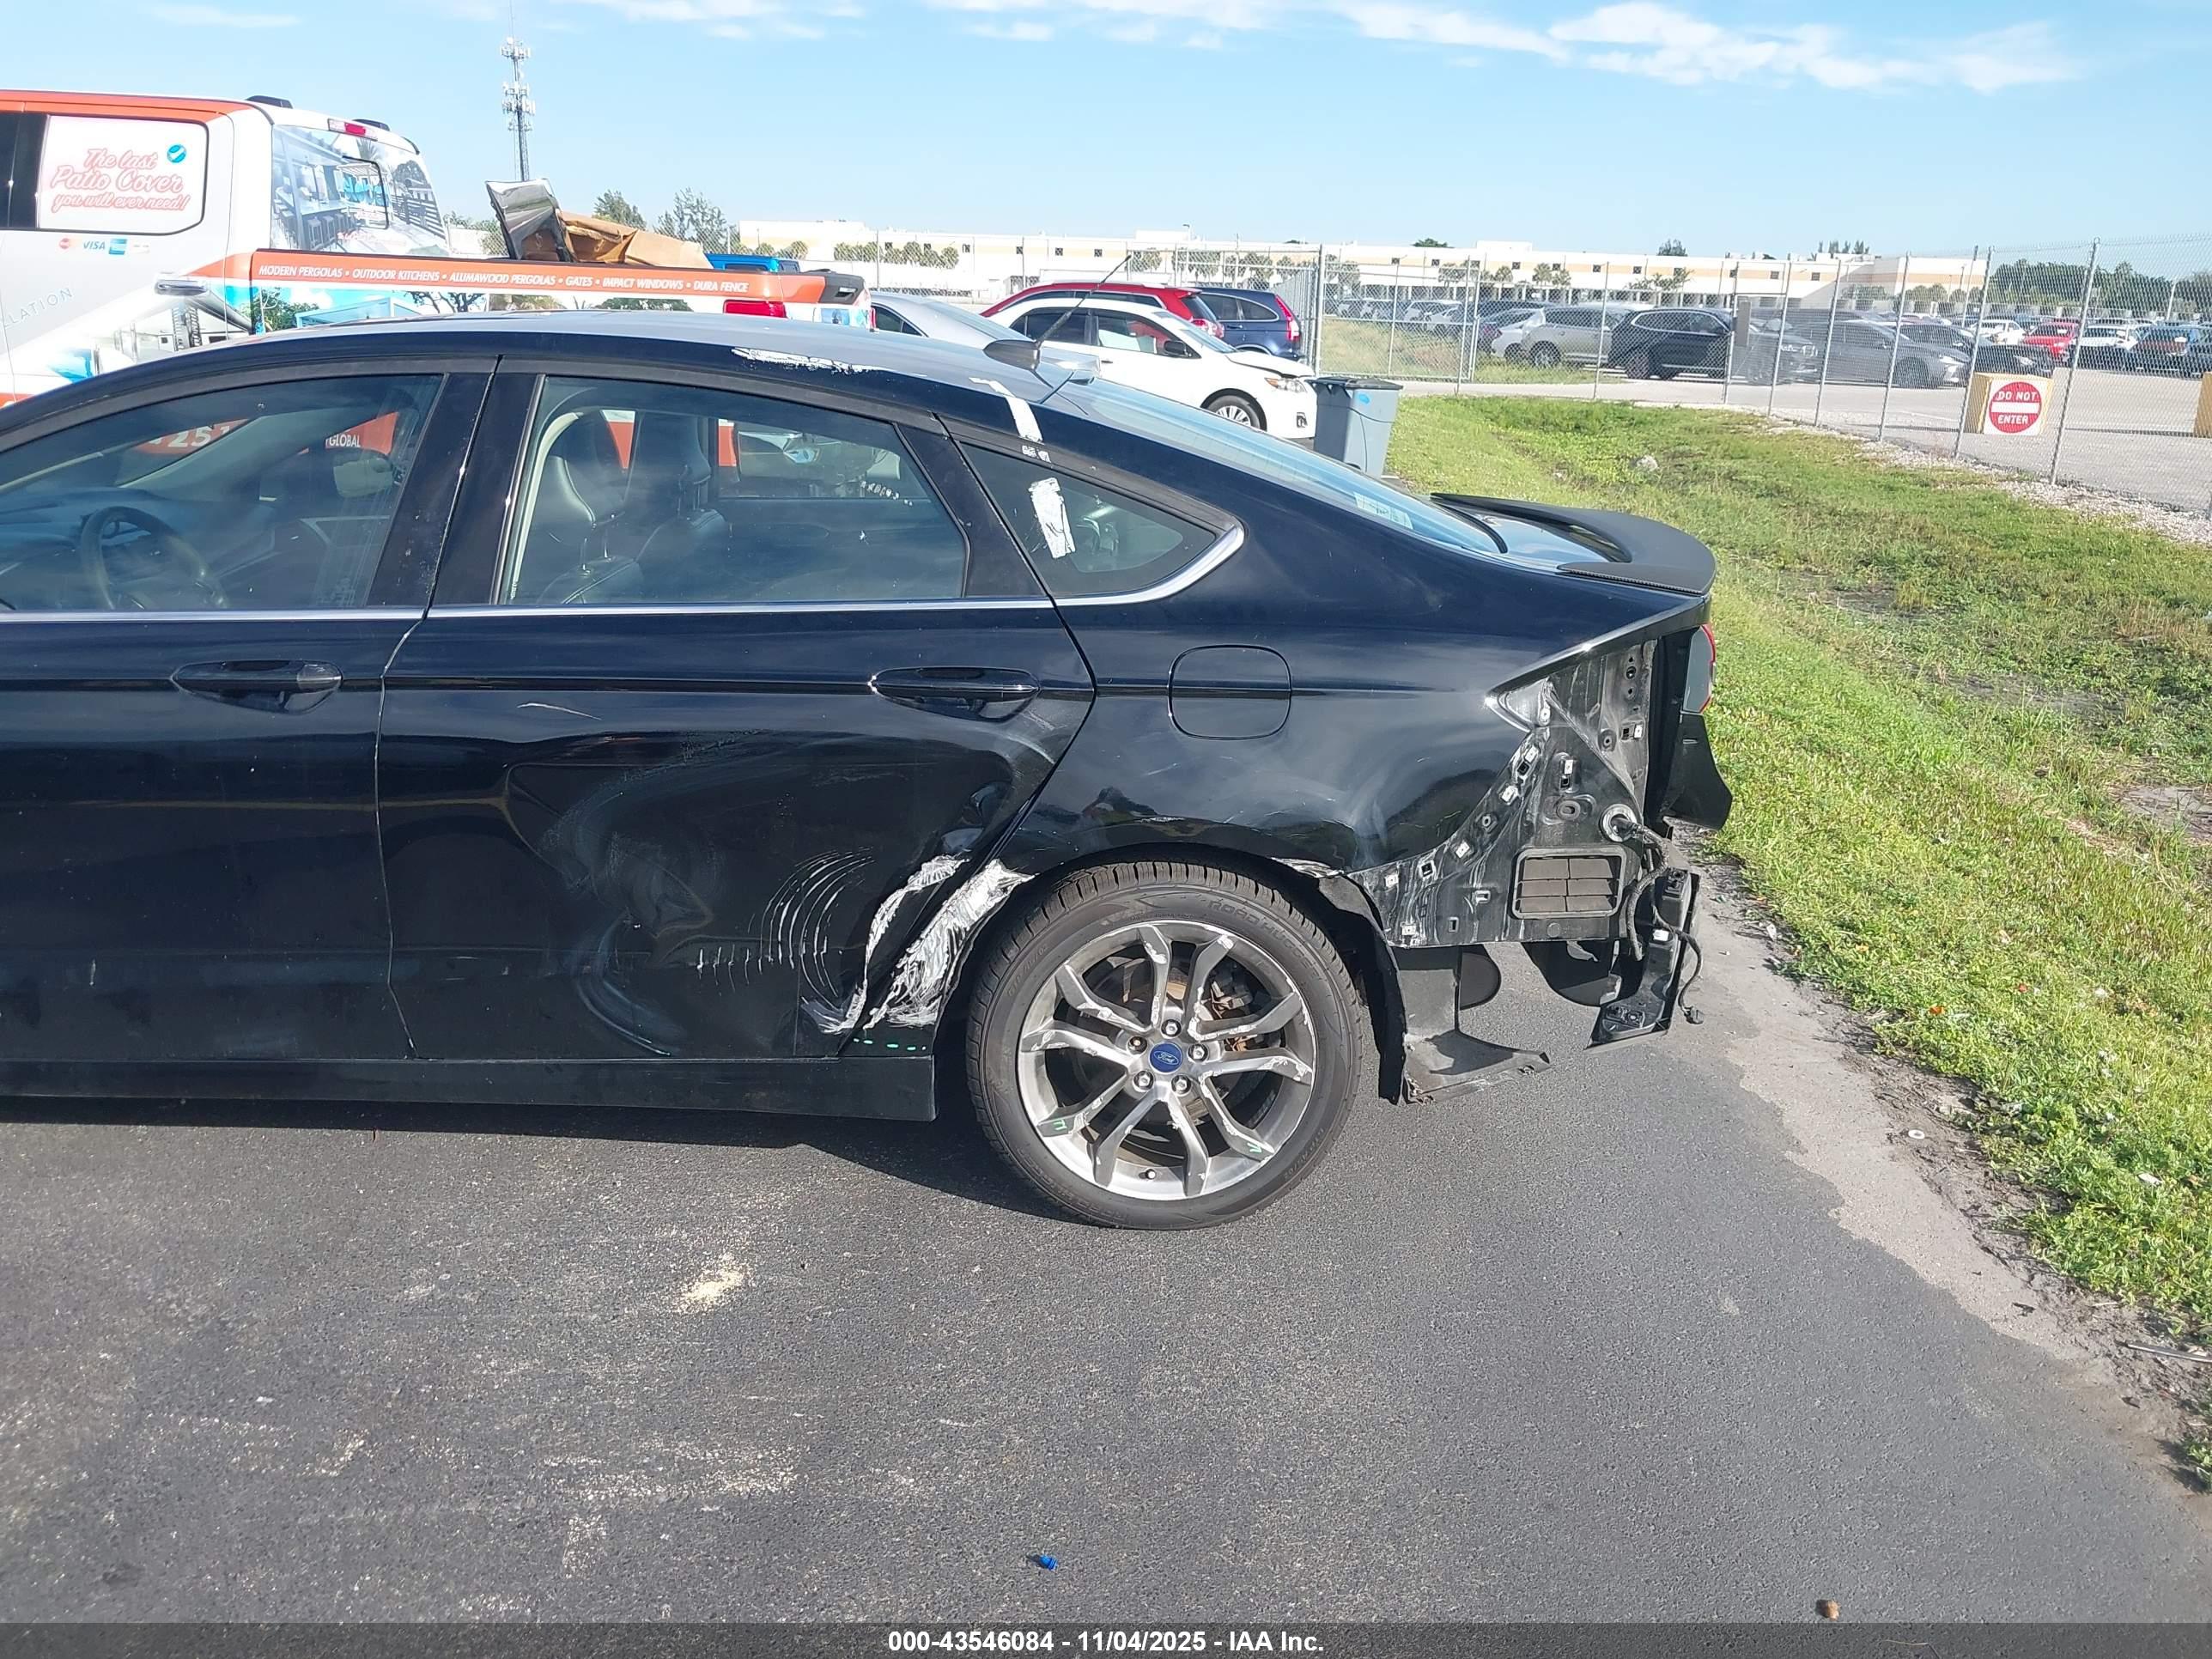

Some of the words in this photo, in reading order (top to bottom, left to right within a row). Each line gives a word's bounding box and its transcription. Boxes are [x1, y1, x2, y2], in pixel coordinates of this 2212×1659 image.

[83, 149, 117, 171] The
[118, 150, 158, 170] last
[50, 165, 111, 190] Patio
[116, 170, 184, 192] Cover
[51, 194, 82, 213] you
[83, 192, 114, 208] will
[113, 196, 145, 210] ever
[145, 195, 191, 211] need!
[83, 240, 106, 250] VISA
[258, 265, 297, 276] MODERN
[299, 266, 343, 277] PERGOLAS
[352, 268, 396, 280] OUTDOOR
[398, 270, 441, 282] KITCHENS
[449, 271, 508, 284] ALUMAWOOD
[511, 274, 556, 286] PERGOLAS
[565, 276, 593, 287] GATES
[603, 276, 634, 289] IMPACT
[636, 277, 684, 290] WINDOWS
[694, 280, 718, 291] DURA
[720, 281, 750, 293] FENCE
[1997, 391, 2012, 401] DO
[2015, 391, 2039, 401] NOT
[1997, 414, 2029, 425] ENTER
[329, 433, 362, 447] GLOBAL
